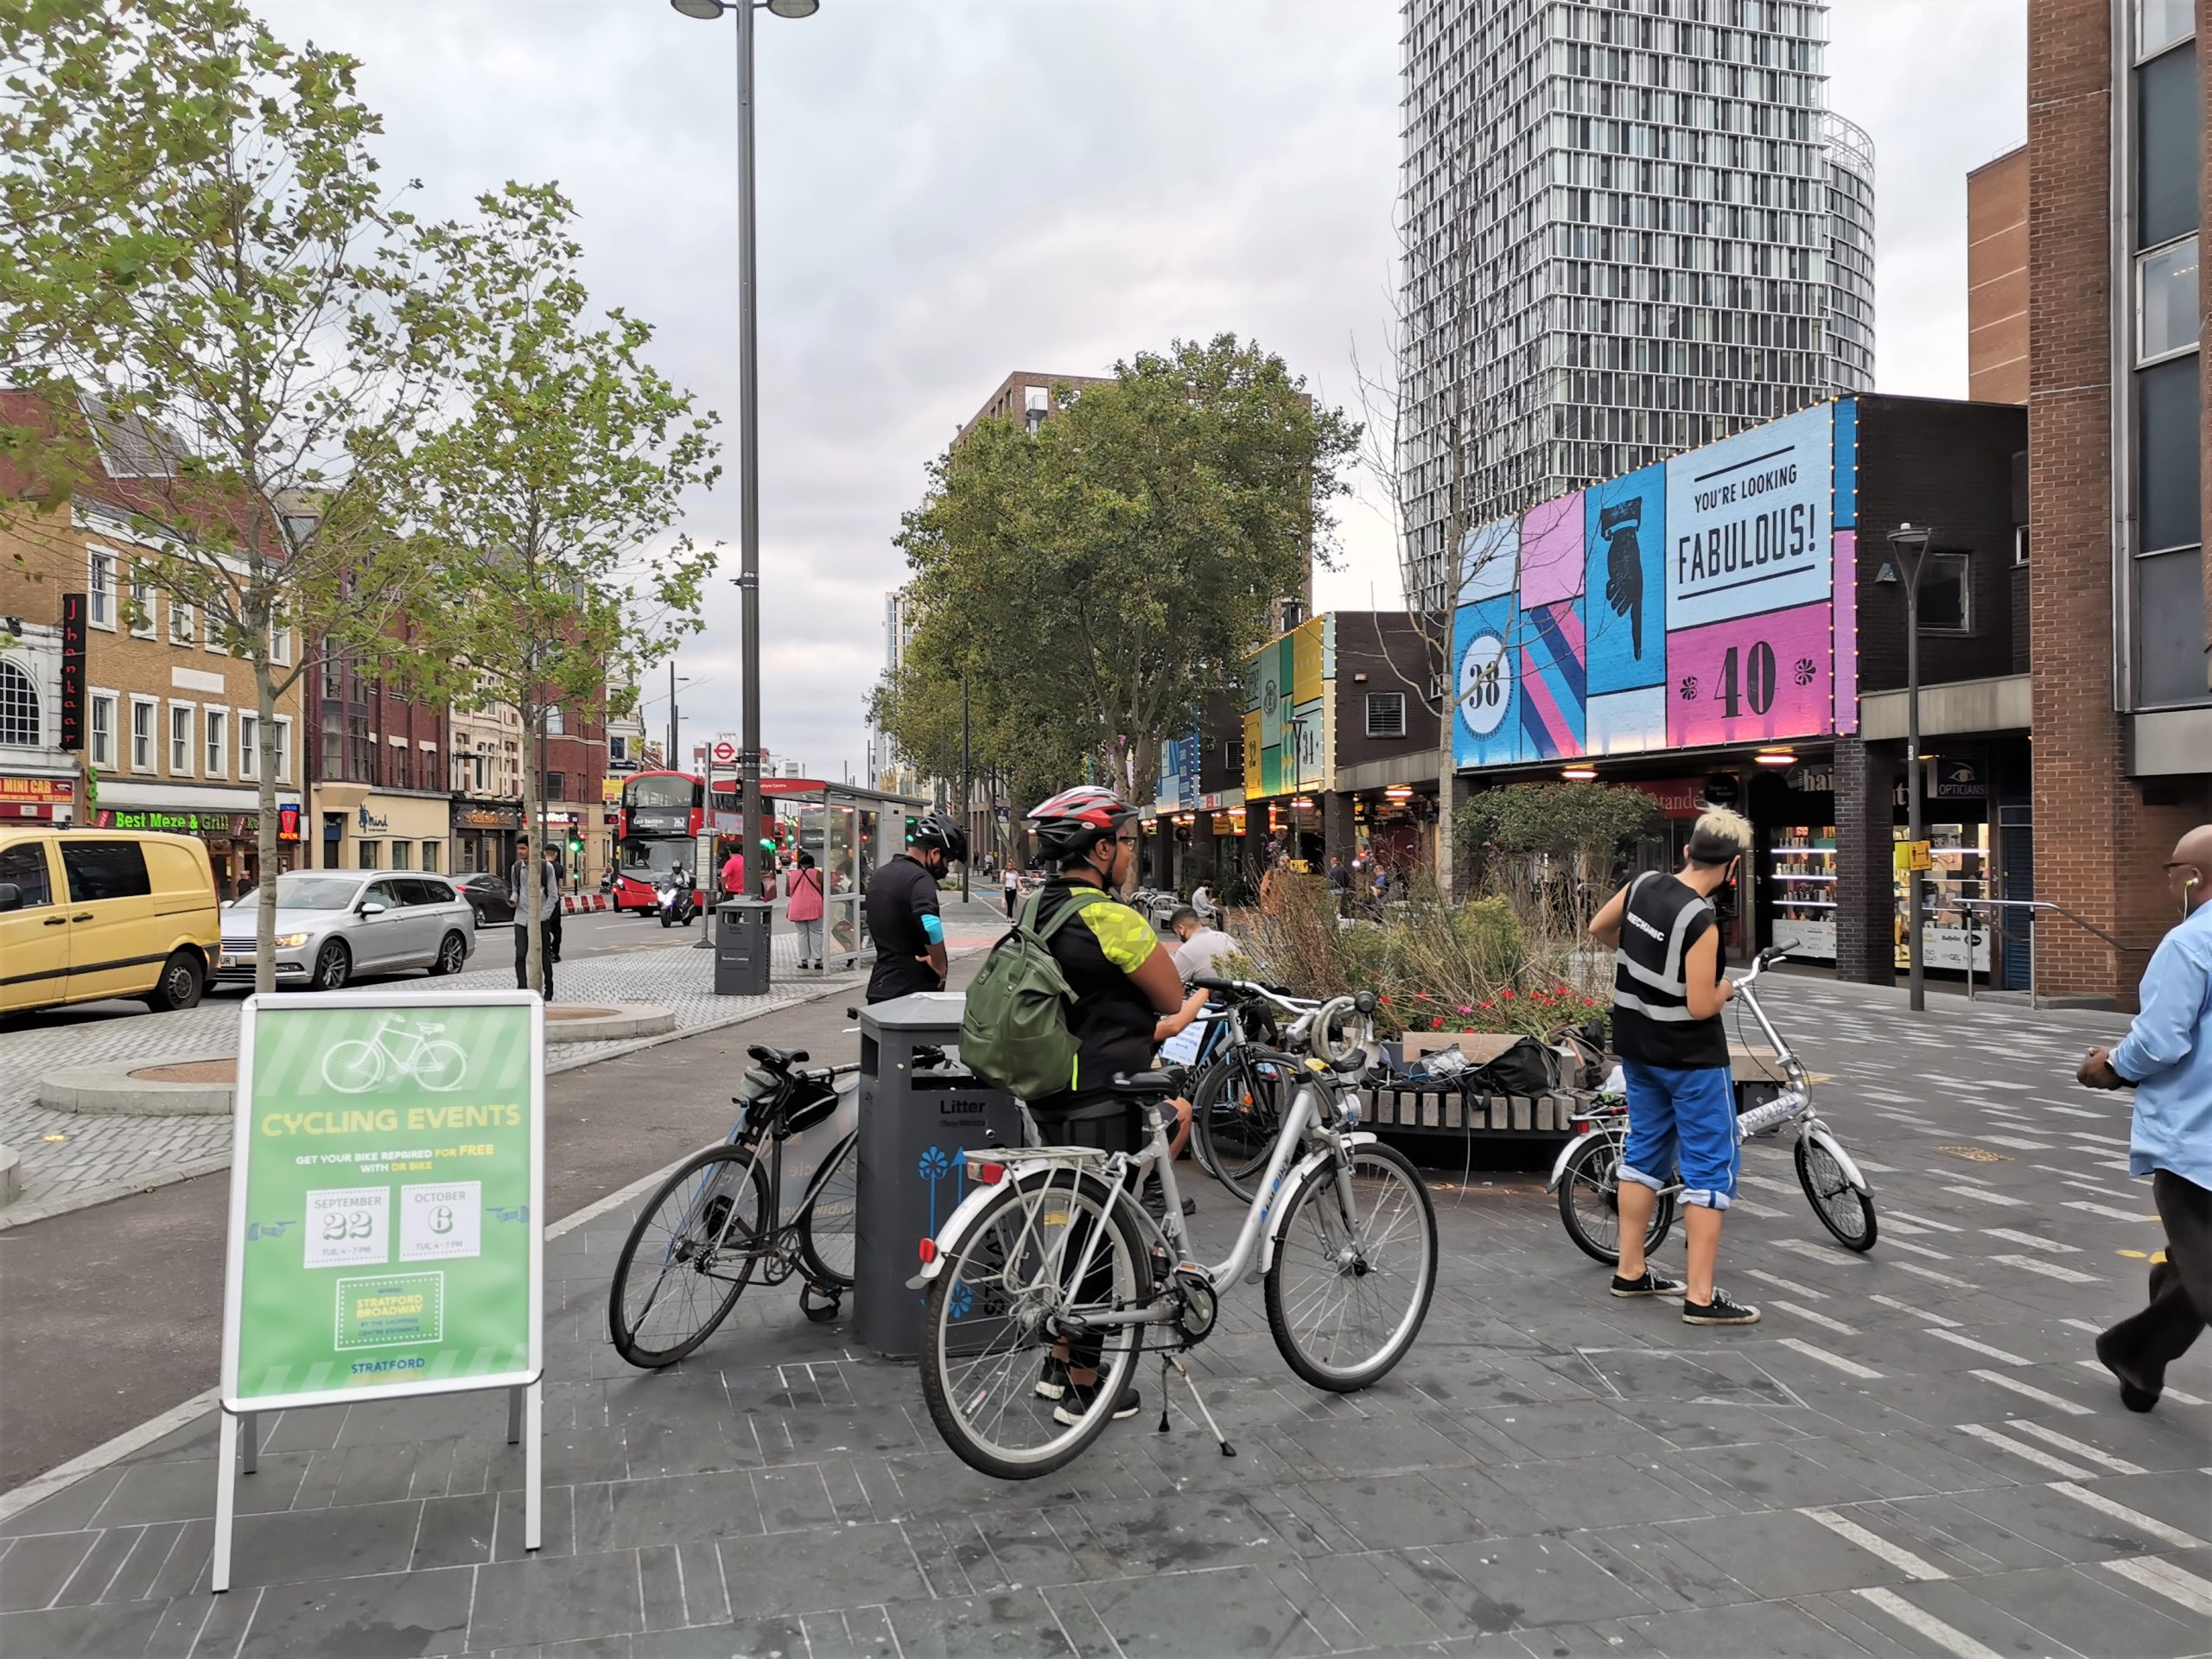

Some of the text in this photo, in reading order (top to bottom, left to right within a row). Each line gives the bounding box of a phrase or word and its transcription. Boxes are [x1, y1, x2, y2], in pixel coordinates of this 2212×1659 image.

[1694, 463, 1797, 513] YOU'RE LOOKING
[1679, 503, 1816, 585] FABULOUS!
[1468, 660, 1501, 709] 38
[1713, 640, 1777, 720] 40
[3, 779, 52, 794] MINI CAB
[1802, 767, 1834, 791] hai
[1656, 787, 1703, 810] tande
[1939, 784, 1985, 795] OPTICIANS
[115, 811, 146, 828] Best
[149, 813, 187, 828] Meze
[188, 814, 199, 830] &
[202, 815, 230, 830] Grill
[673, 817, 685, 828] 262
[1627, 912, 1665, 942] MECHANIC
[940, 1100, 986, 1114] Litter
[261, 1103, 521, 1137] CYCLING EVENTS
[296, 1144, 494, 1165] GET YOUR BIKE REPAIRED FOR FREE
[360, 1160, 432, 1173] WITH DR BIKE
[315, 1197, 382, 1209] SEPTEMBER
[415, 1191, 467, 1203] OCTOBER
[323, 1211, 372, 1241] 22
[428, 1205, 453, 1234] 6
[356, 1304, 423, 1318] BROADWAY
[357, 1294, 423, 1308] STRATFORD
[351, 1357, 425, 1374] STRATFORD
